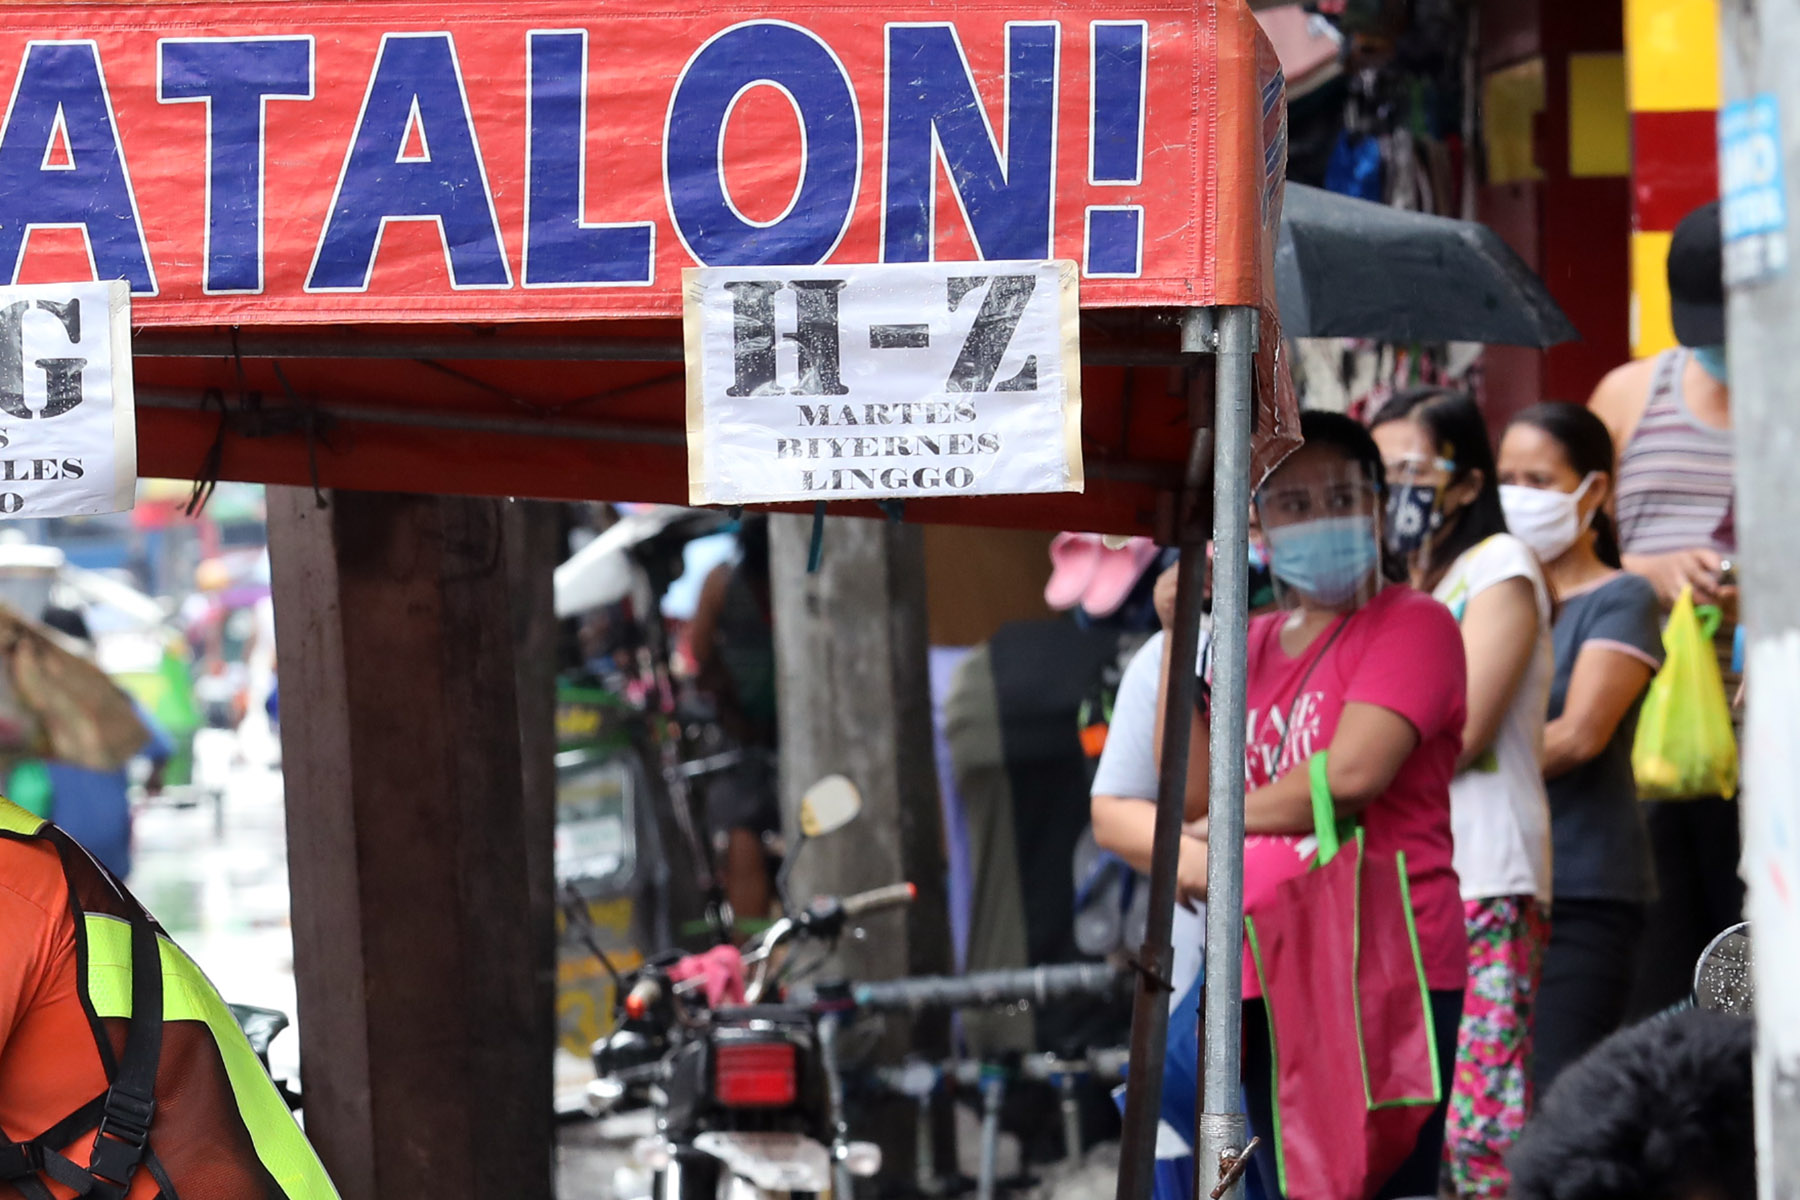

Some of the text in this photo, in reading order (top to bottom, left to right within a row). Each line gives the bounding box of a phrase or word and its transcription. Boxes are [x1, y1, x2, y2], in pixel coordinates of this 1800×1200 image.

[723, 275, 1038, 397] H-Z
[796, 402, 977, 427] MARTES
[777, 432, 1001, 459] BIYERNES
[801, 466, 974, 491] LINGGO
